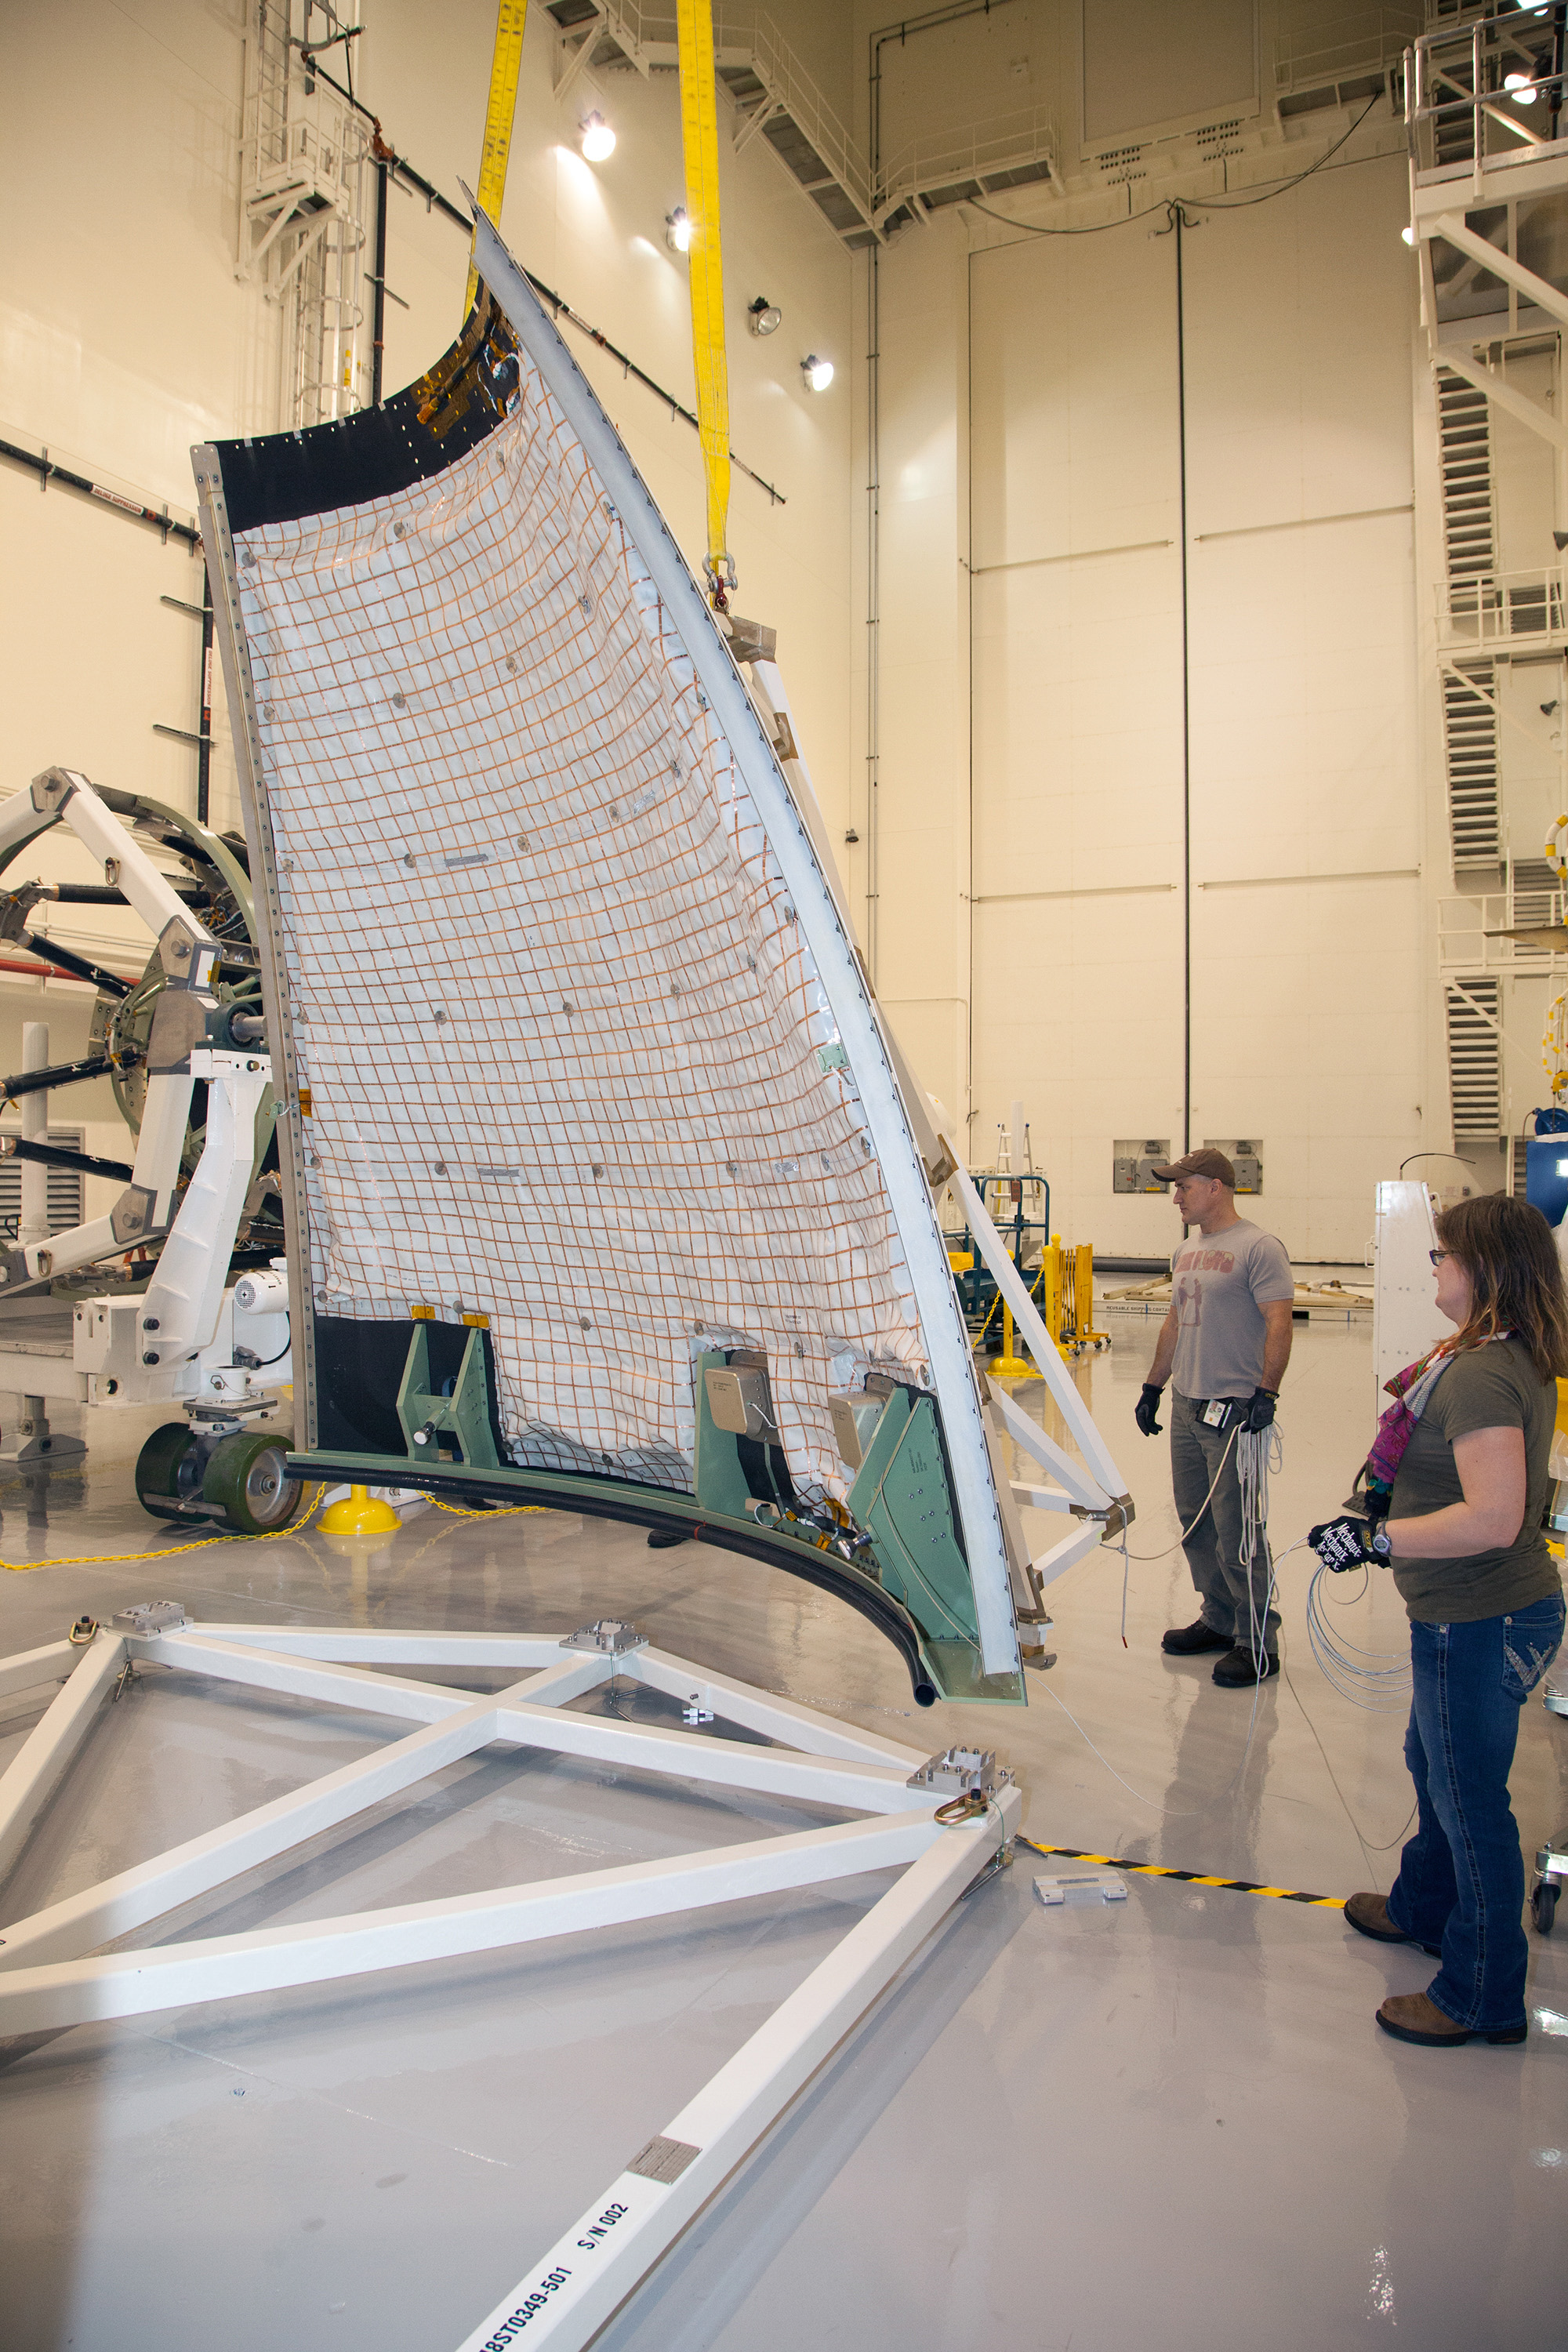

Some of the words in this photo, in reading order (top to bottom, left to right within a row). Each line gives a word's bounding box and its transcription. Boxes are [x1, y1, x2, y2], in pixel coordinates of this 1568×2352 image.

[1320, 1526, 1348, 1561] Mechanix
[1335, 1522, 1362, 1557] Mechanix
[478, 2267, 572, 2352] 8ST0349-501
[577, 2226, 608, 2250] S/N
[599, 2203, 629, 2226] 002
